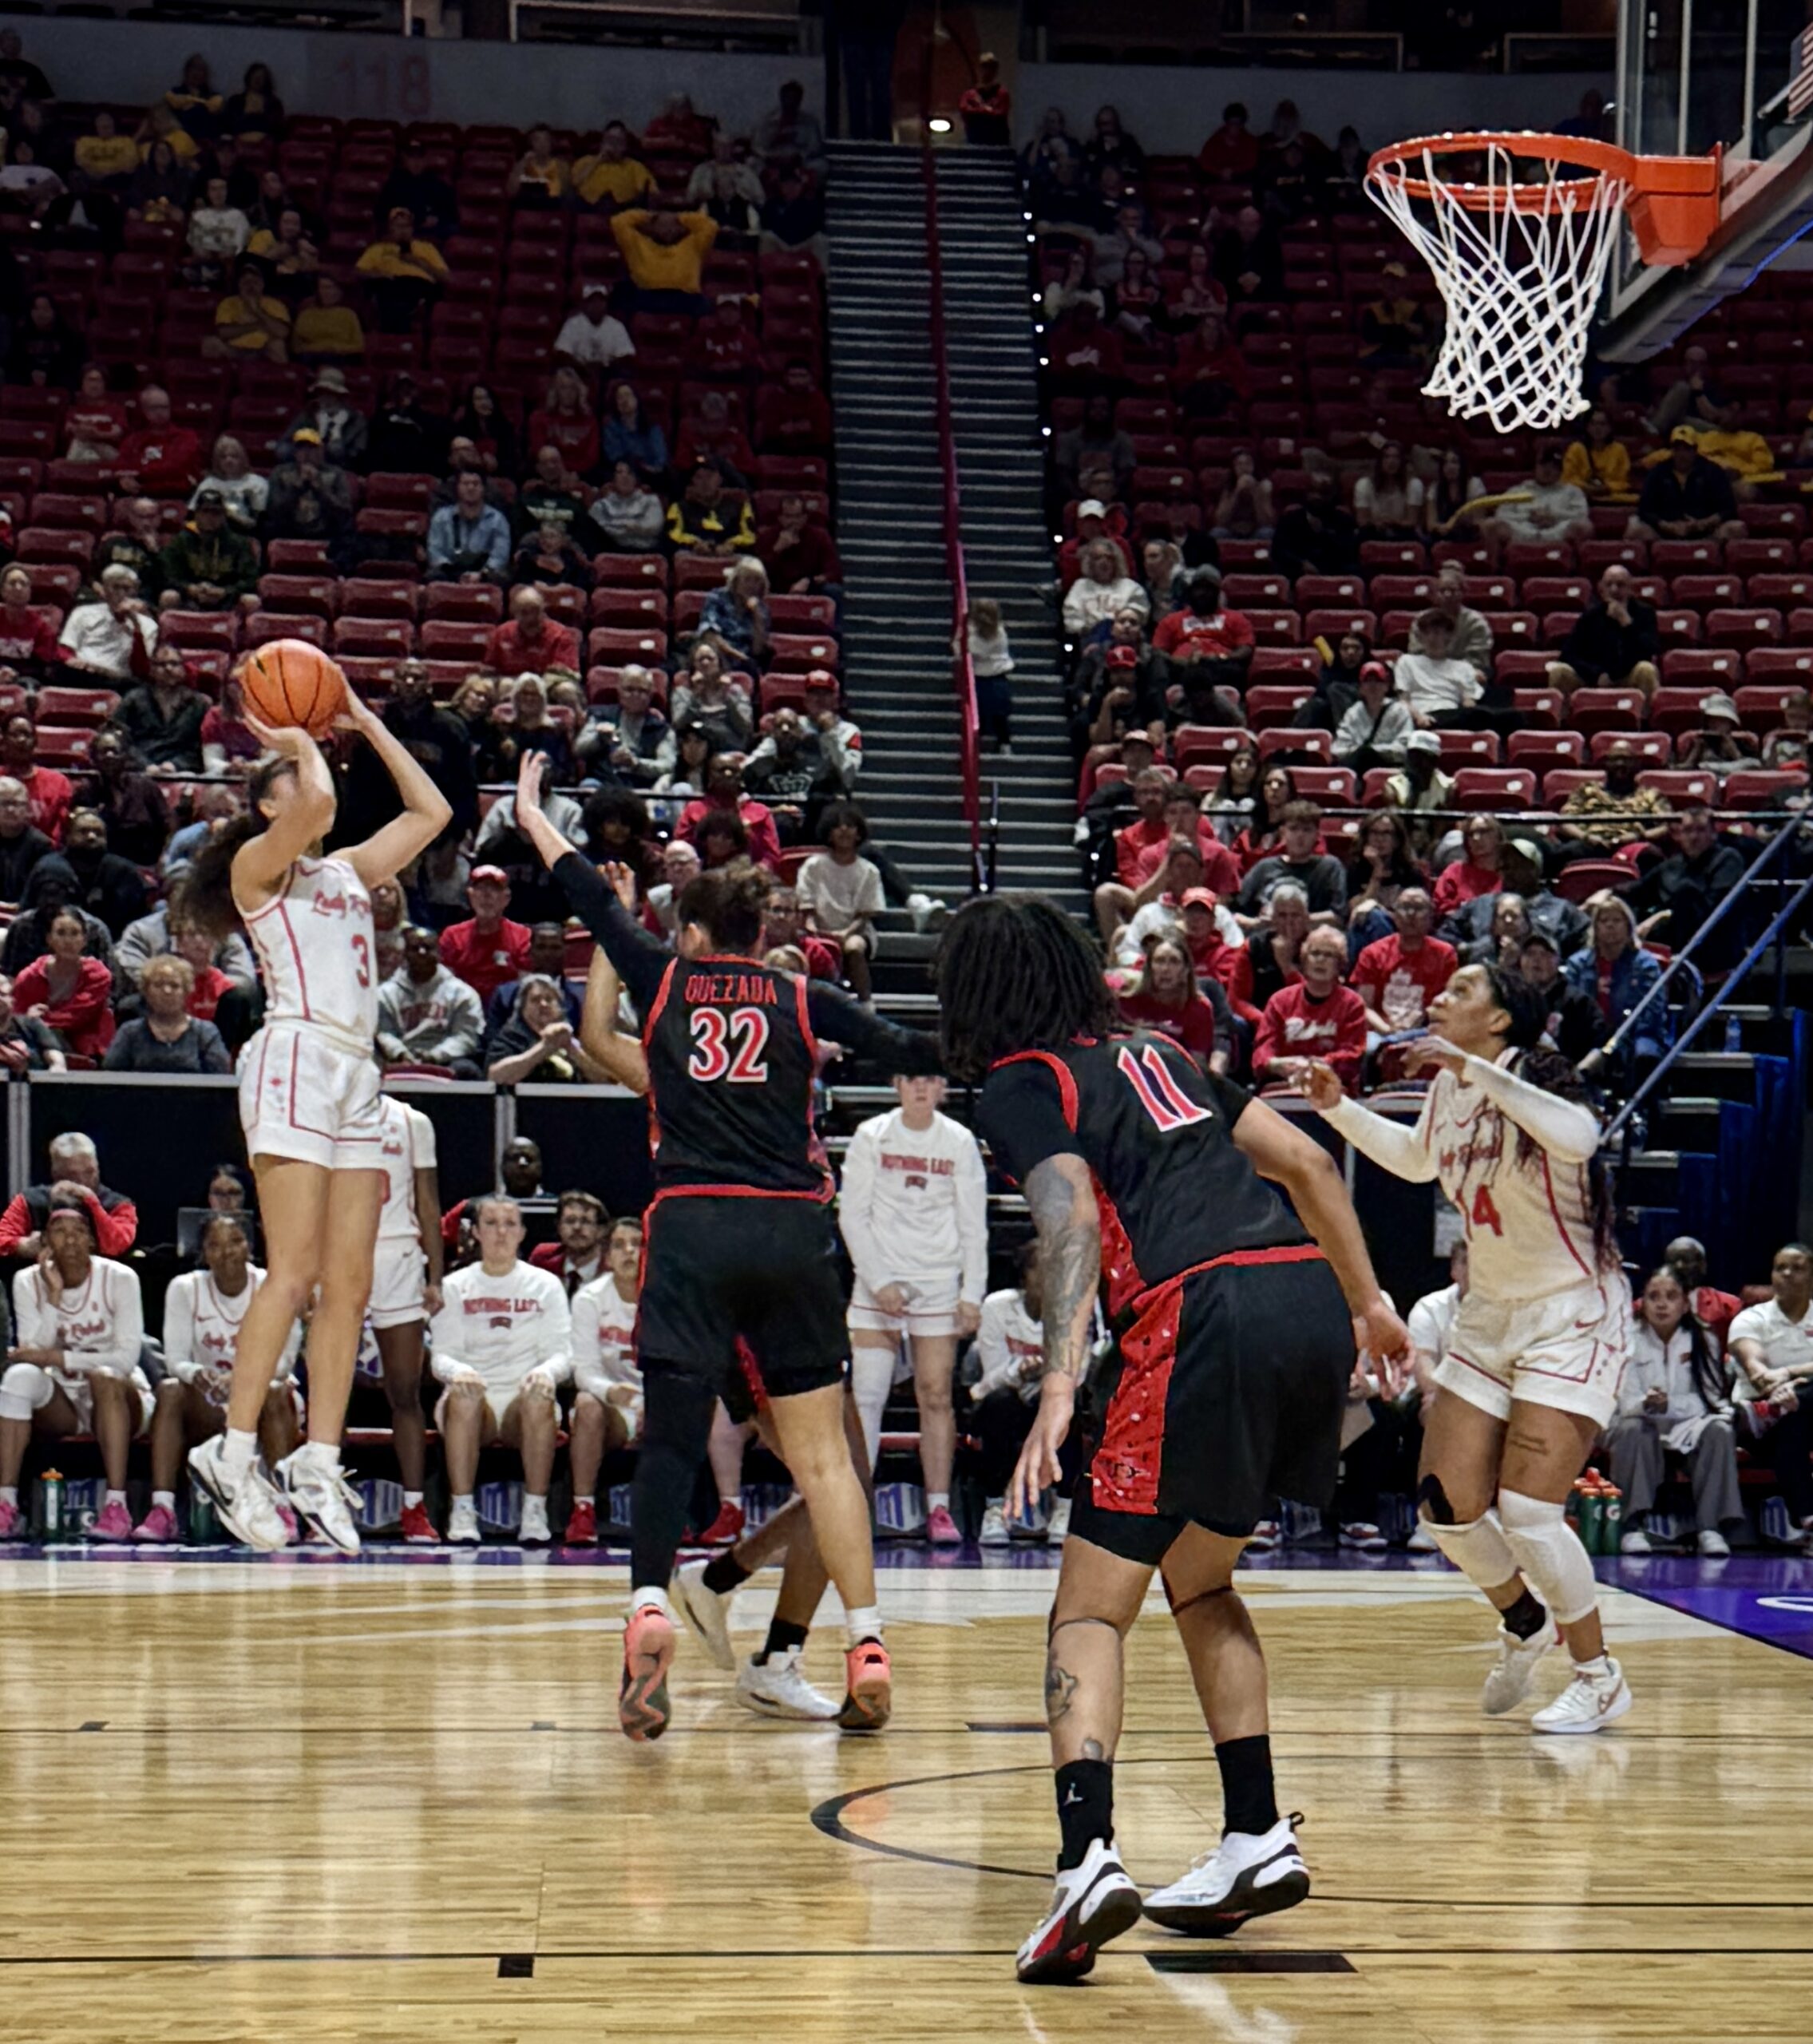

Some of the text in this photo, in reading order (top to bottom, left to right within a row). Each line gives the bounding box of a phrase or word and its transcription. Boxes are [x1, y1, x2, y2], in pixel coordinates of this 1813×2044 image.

[336, 54, 431, 116] 118
[351, 933, 370, 988] 3
[688, 1007, 770, 1083] 32
[1118, 1044, 1213, 1132] 11
